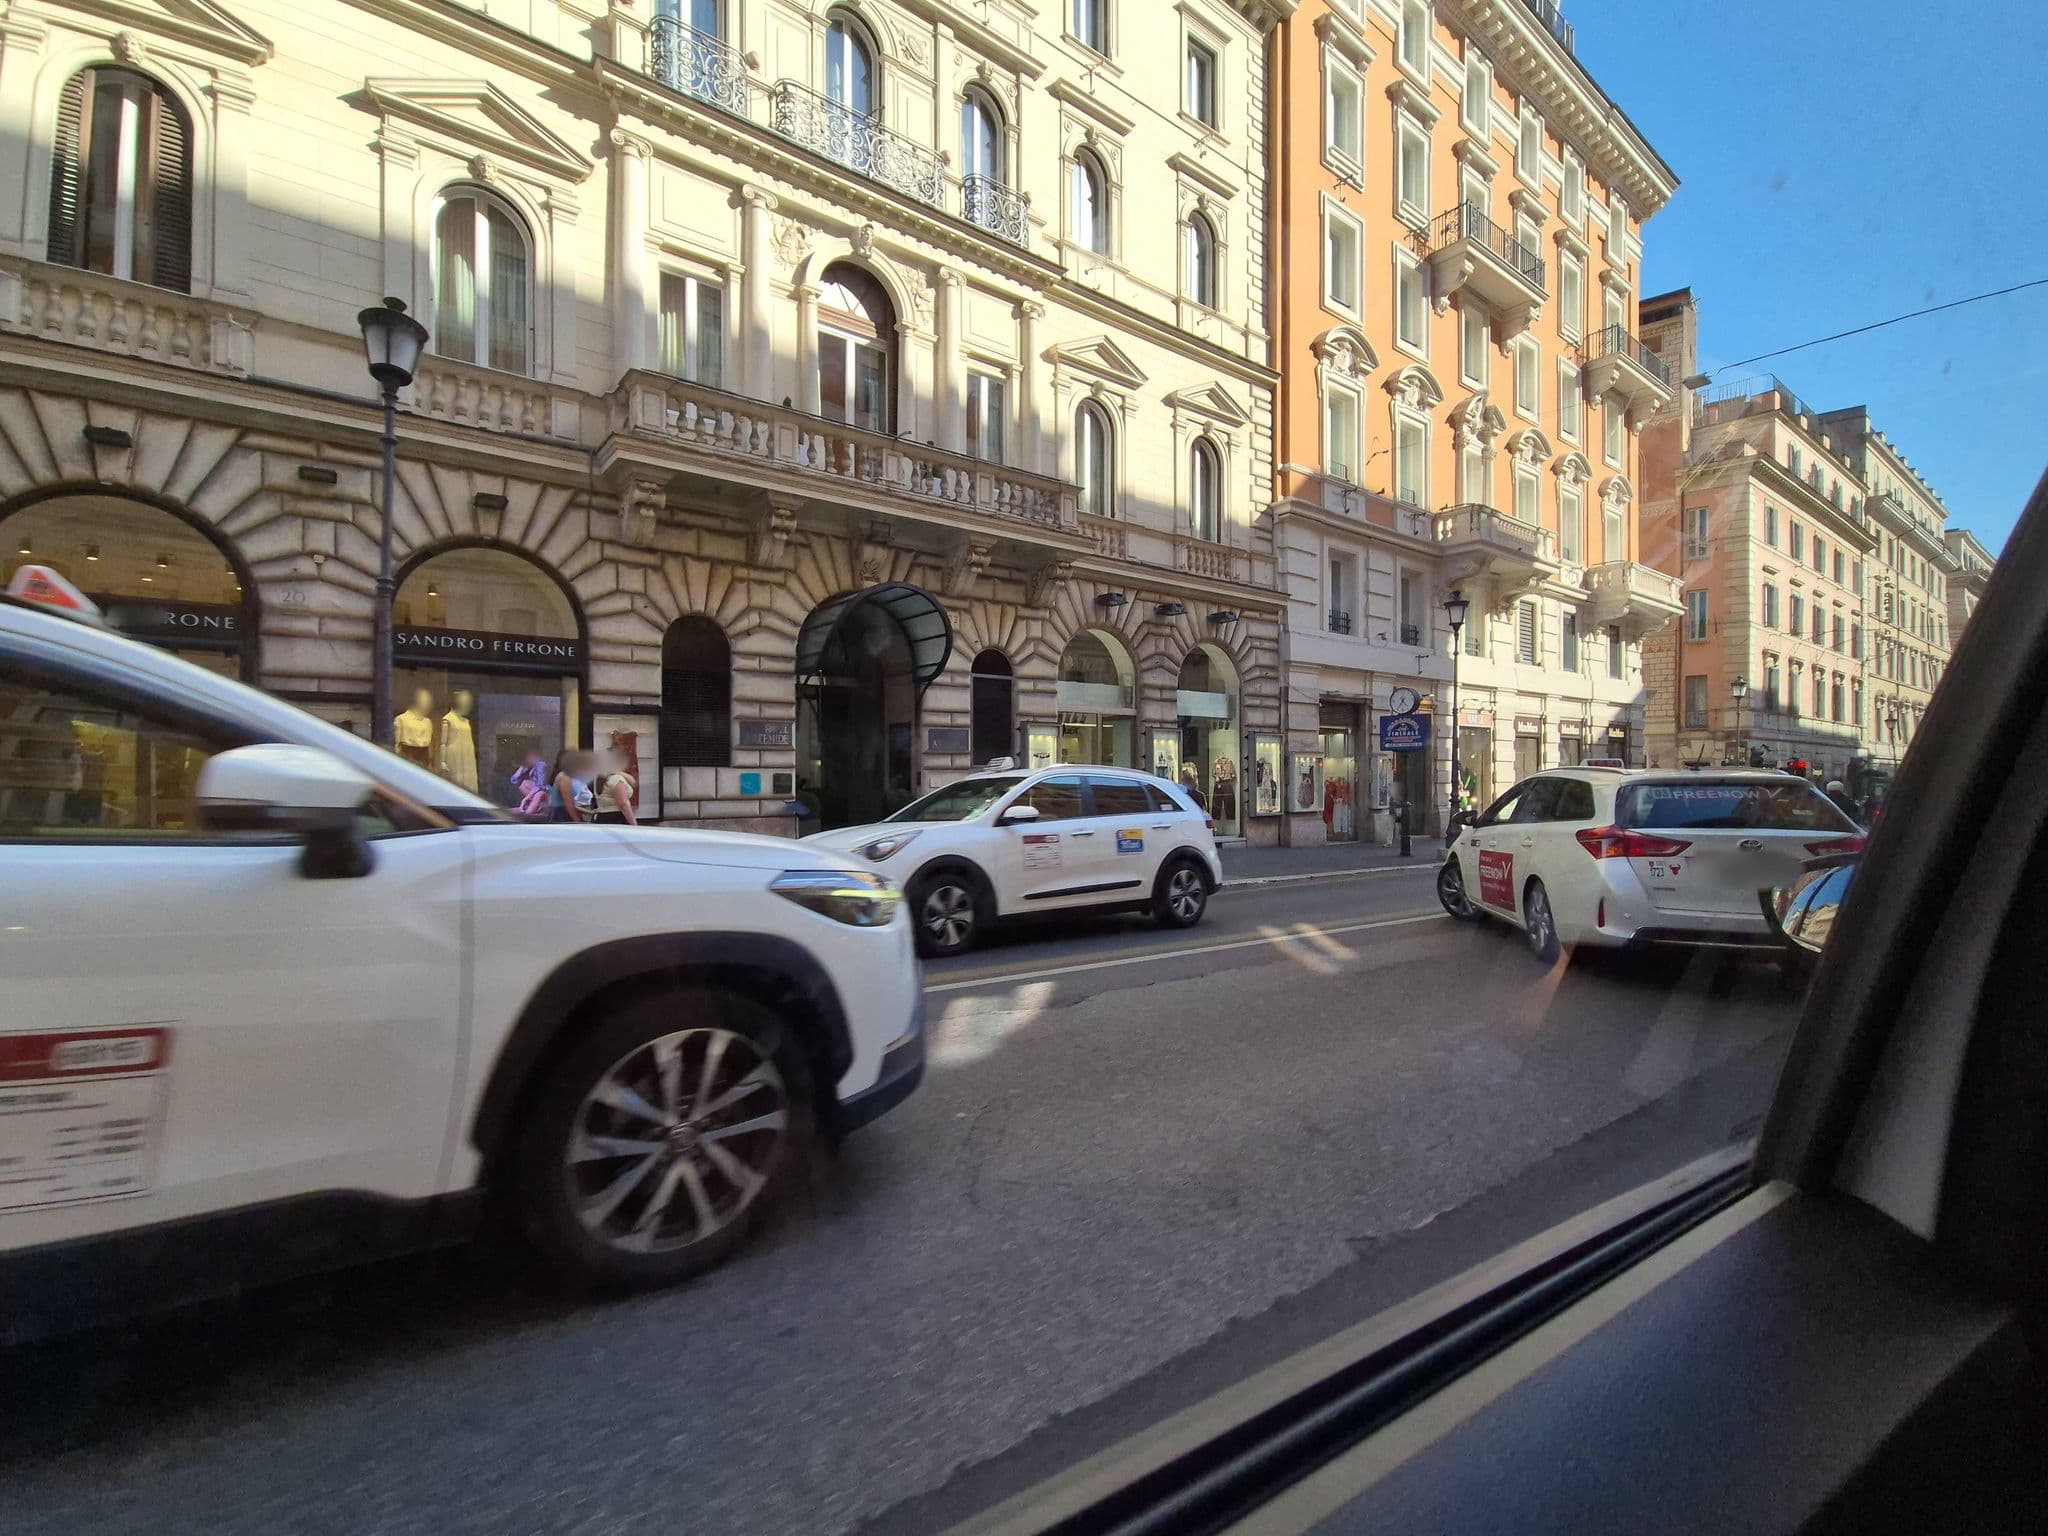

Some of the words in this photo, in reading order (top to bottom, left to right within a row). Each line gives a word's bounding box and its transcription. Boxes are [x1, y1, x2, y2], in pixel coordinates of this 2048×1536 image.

[281, 591, 306, 604] 20
[396, 632, 485, 650] SANDRO
[492, 640, 576, 657] FERRONE
[1673, 789, 1760, 800] FREENOW
